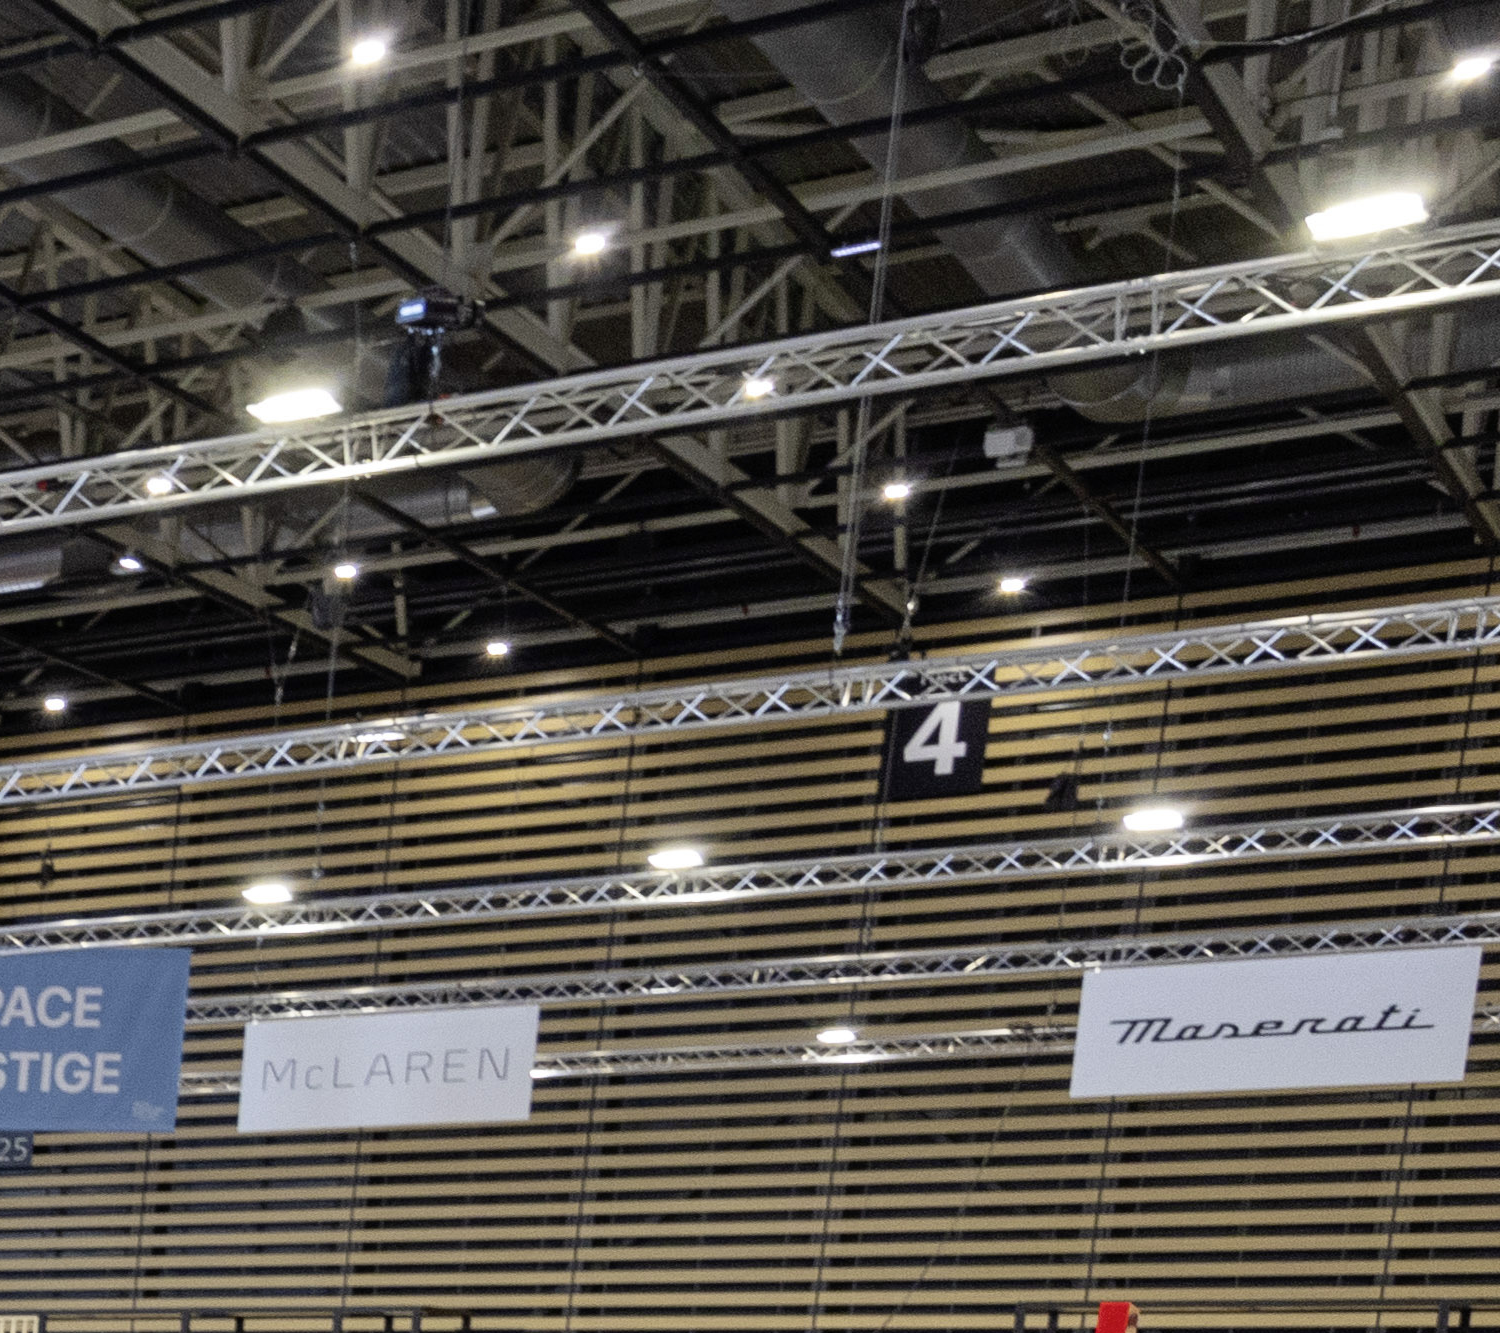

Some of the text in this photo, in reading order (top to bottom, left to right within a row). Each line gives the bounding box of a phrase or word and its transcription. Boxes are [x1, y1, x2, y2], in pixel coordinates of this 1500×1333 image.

[902, 699, 968, 775] 4
[1109, 1003, 1435, 1045] Maserati
[261, 1045, 511, 1092] McLAREN
